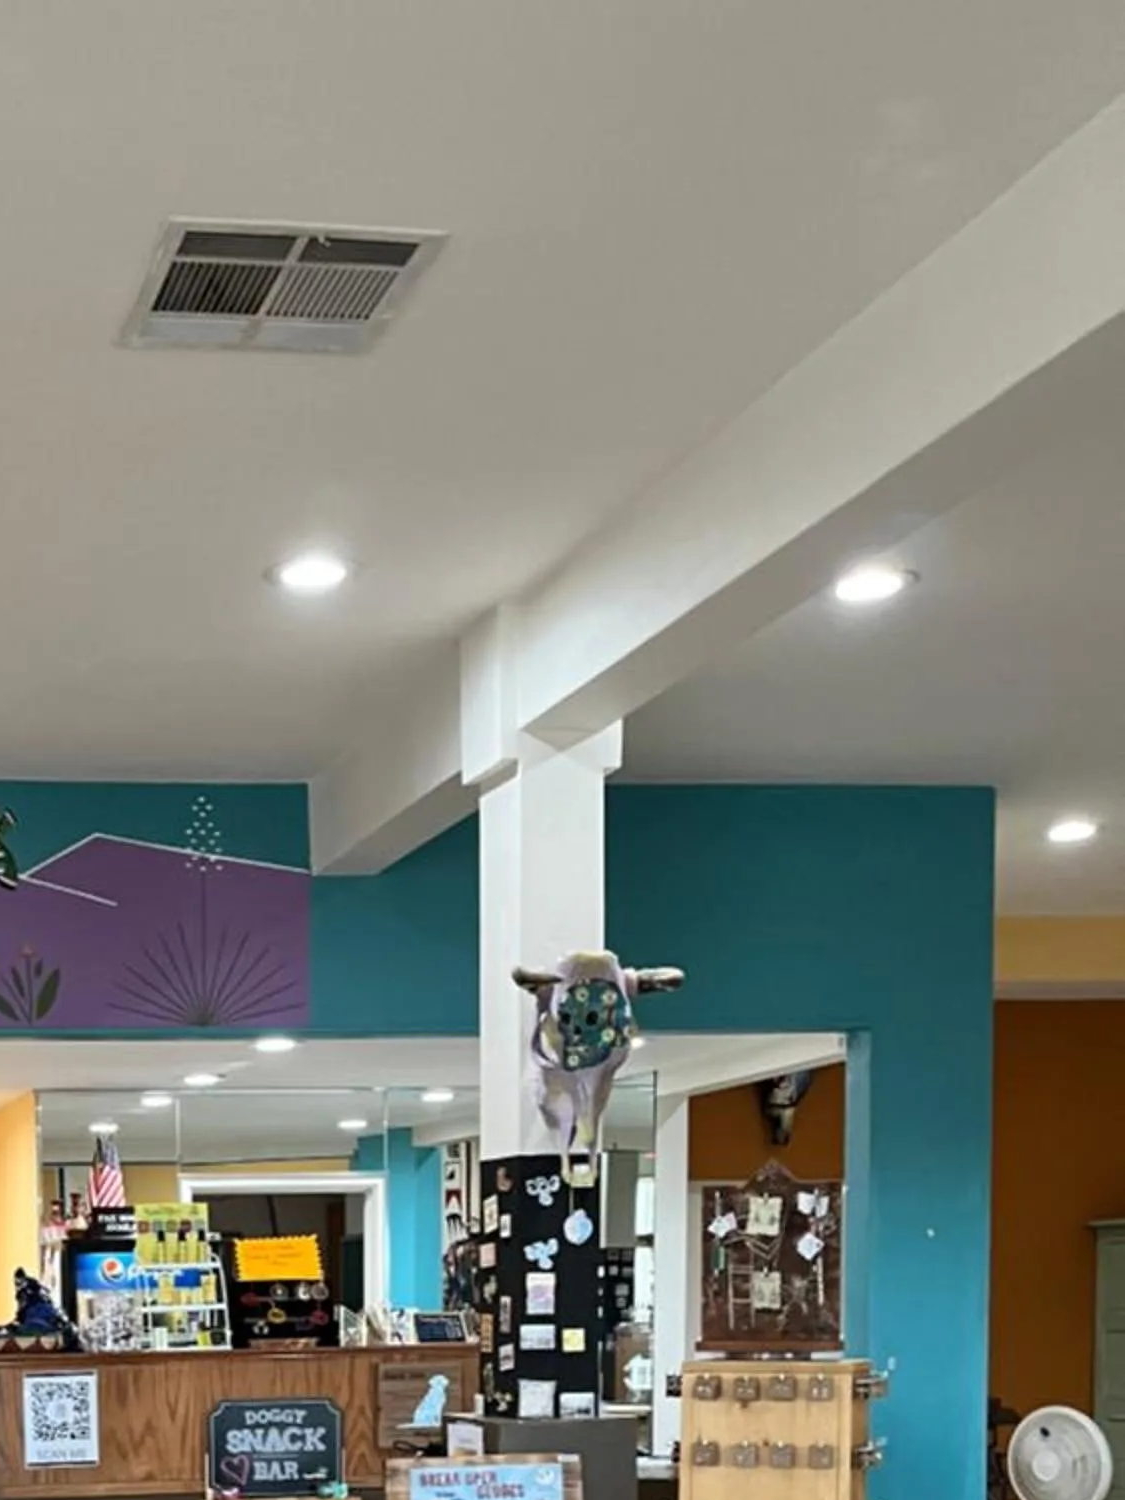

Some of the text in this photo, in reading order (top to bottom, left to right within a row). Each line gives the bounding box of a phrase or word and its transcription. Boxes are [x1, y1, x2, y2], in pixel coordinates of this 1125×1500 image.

[244, 1408, 306, 1425] DOGGY
[225, 1426, 327, 1453] SNACK
[253, 1461, 299, 1480] BAR
